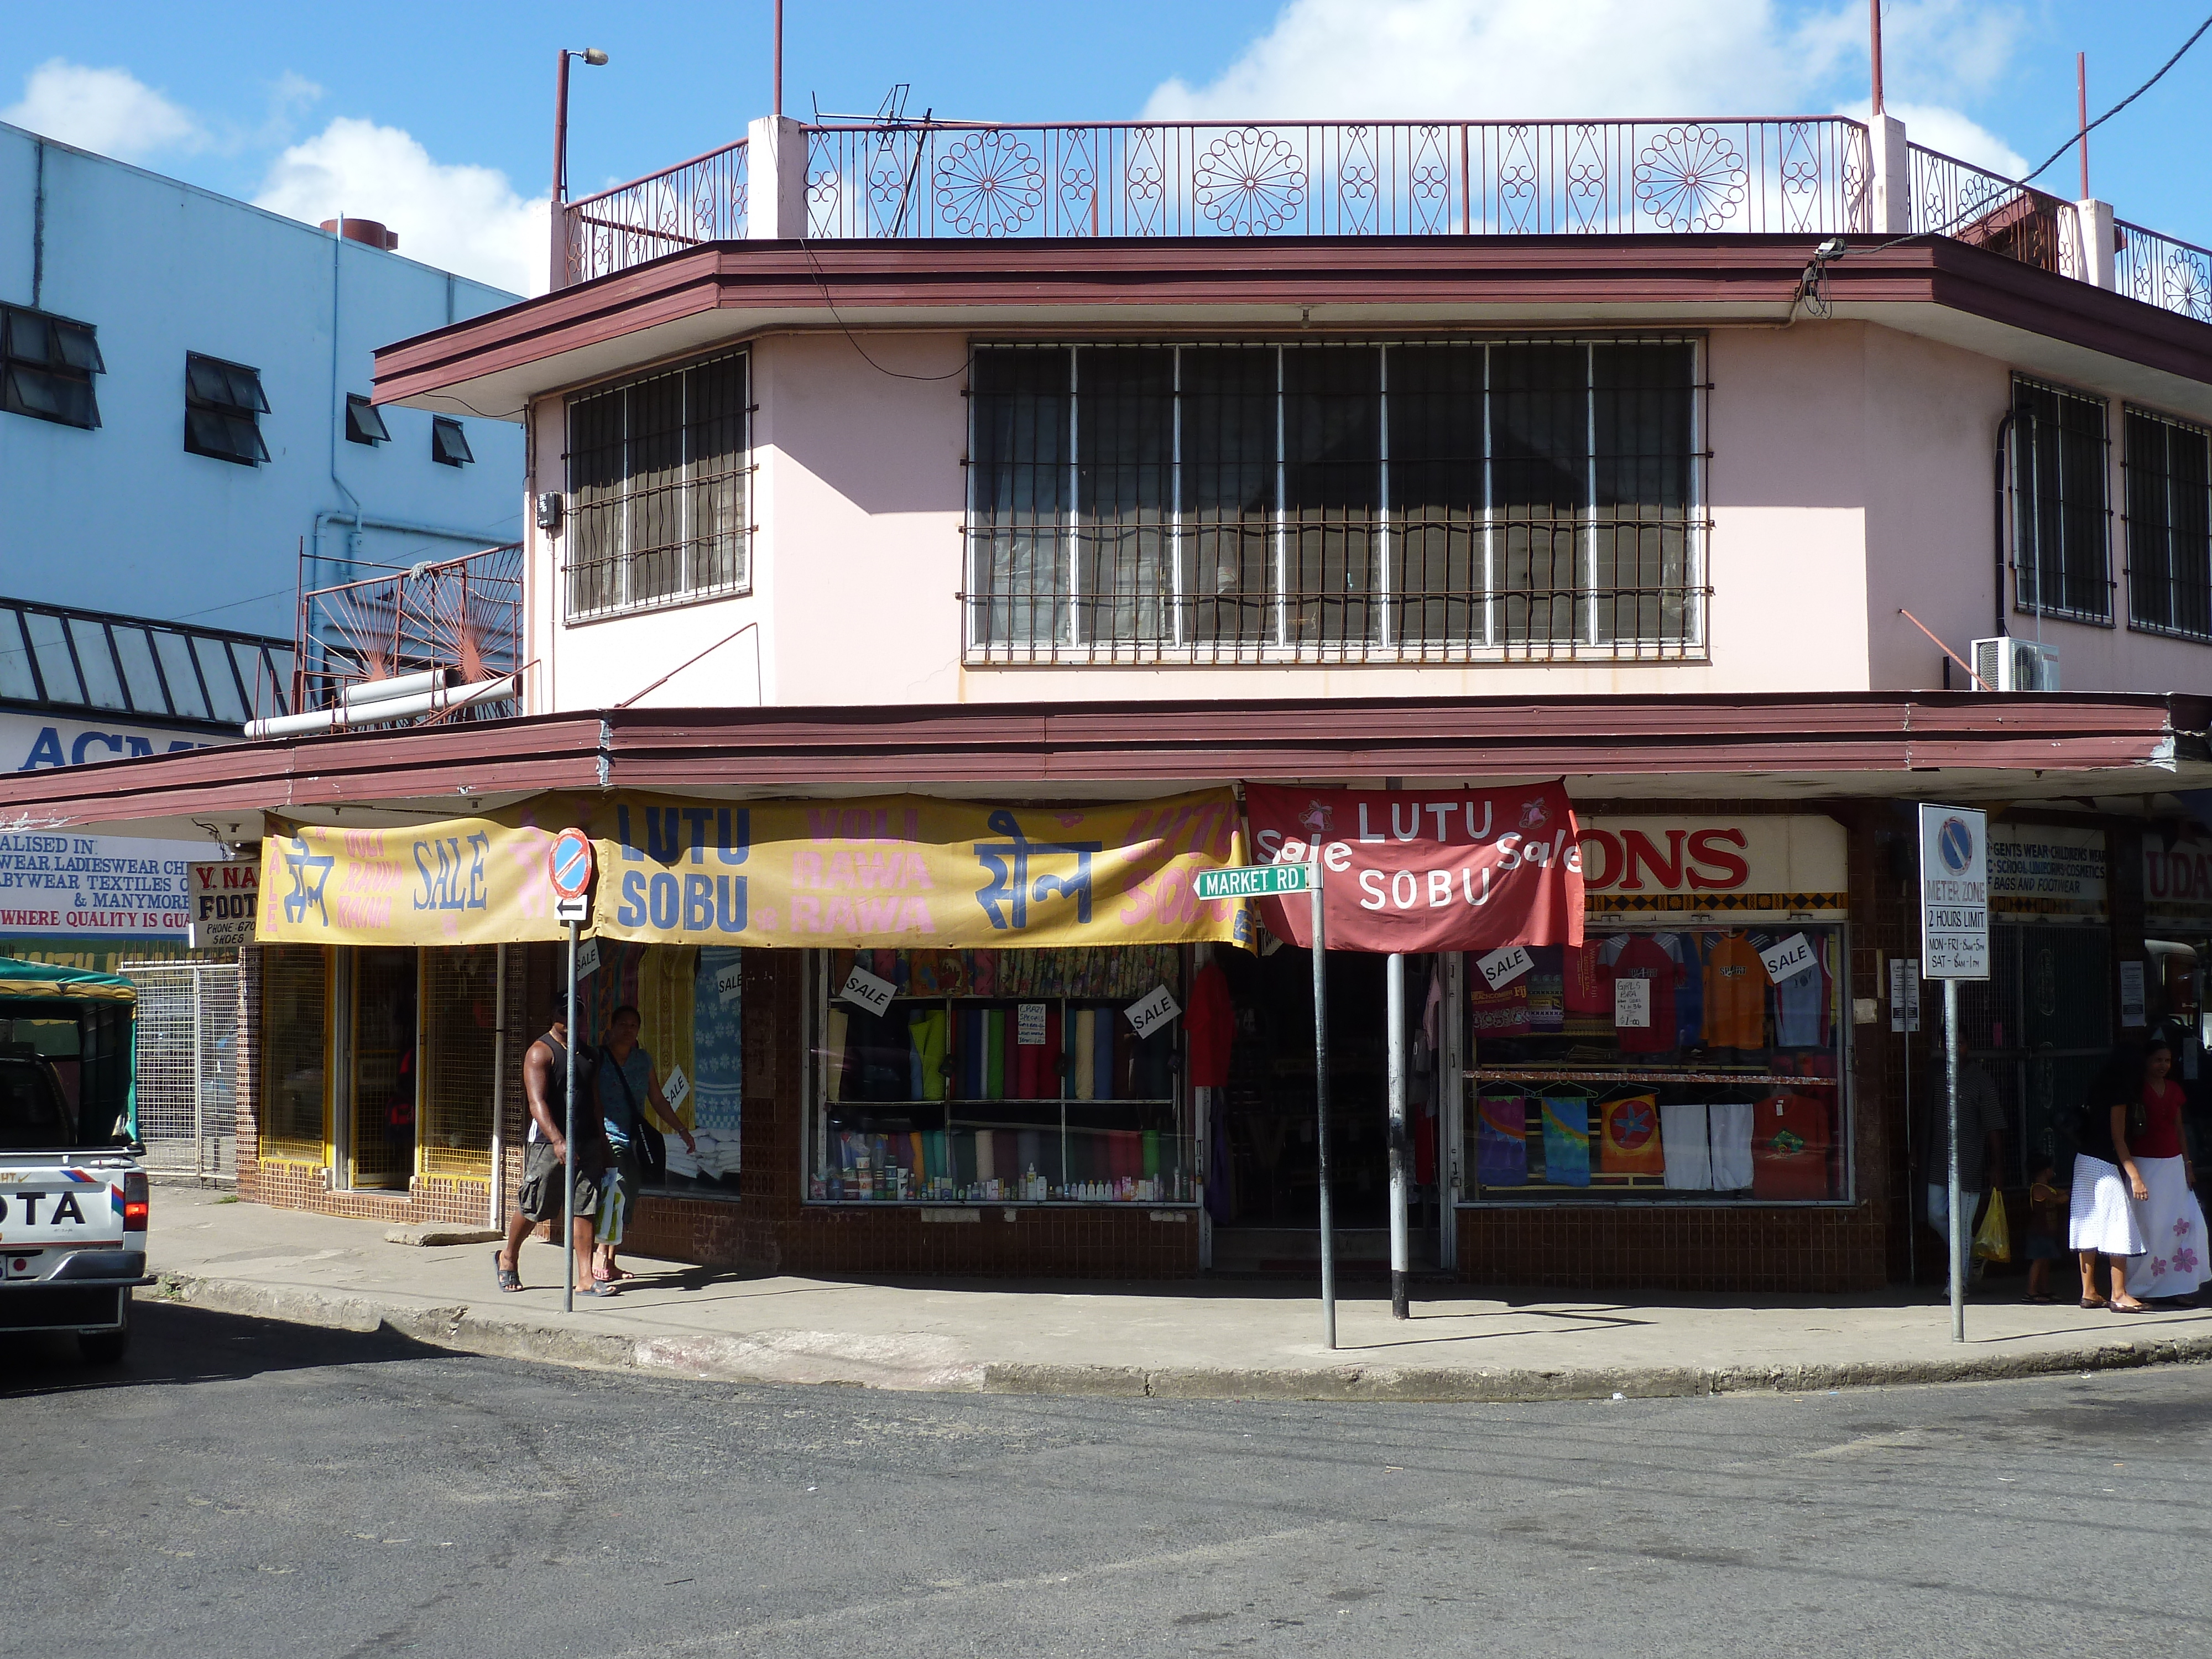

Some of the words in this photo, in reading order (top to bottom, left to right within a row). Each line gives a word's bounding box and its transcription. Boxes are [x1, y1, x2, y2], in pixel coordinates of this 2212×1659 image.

[18, 727, 215, 770] AC
[617, 804, 750, 866] LUTU
[806, 808, 919, 845] VOLI
[1359, 801, 1491, 844] LUTU
[0, 834, 67, 852] ALISED
[1256, 829, 1352, 873] Sale
[1496, 829, 1583, 873] Sale
[1993, 843, 2022, 858] GENTS
[413, 830, 491, 911] SALE
[791, 851, 935, 889] RAWA
[973, 810, 1103, 929] सेल
[1576, 828, 1750, 891] ONS
[1997, 859, 2027, 874] SCHOOL
[0, 873, 80, 889] BYWEAR
[87, 875, 171, 891] TEXTILES
[196, 867, 217, 889] Y.
[222, 866, 261, 889] NA
[1206, 869, 1269, 895] MARKET
[1277, 867, 1299, 889] RD
[1359, 868, 1490, 910] SOBU
[1927, 880, 1960, 902] METER
[1962, 881, 1985, 903] ZONE
[1994, 877, 2016, 891] BAGS
[2018, 878, 2035, 891] AND
[2037, 879, 2080, 894] FOOTWEAR
[75, 893, 87, 907] &
[199, 894, 258, 921] FOOT
[617, 869, 748, 933] SOBU
[790, 896, 936, 933] RAWA
[1, 910, 60, 925] WHERE
[66, 911, 138, 927] QUALITY
[143, 912, 158, 927] IS
[207, 922, 233, 934] PHONE
[1928, 910, 1934, 928] 2
[1936, 910, 1961, 928] HOURS
[1964, 911, 1985, 928] LIMIT
[213, 934, 244, 945] SHOES
[576, 948, 596, 972] SALE
[1485, 950, 1524, 982] SALE
[1767, 945, 1808, 974] SALE
[1932, 955, 1946, 968] SAT
[719, 973, 742, 993] SALE
[846, 977, 889, 1008] SALE
[1134, 997, 1172, 1030] SALE
[0, 1191, 86, 1225] TA
